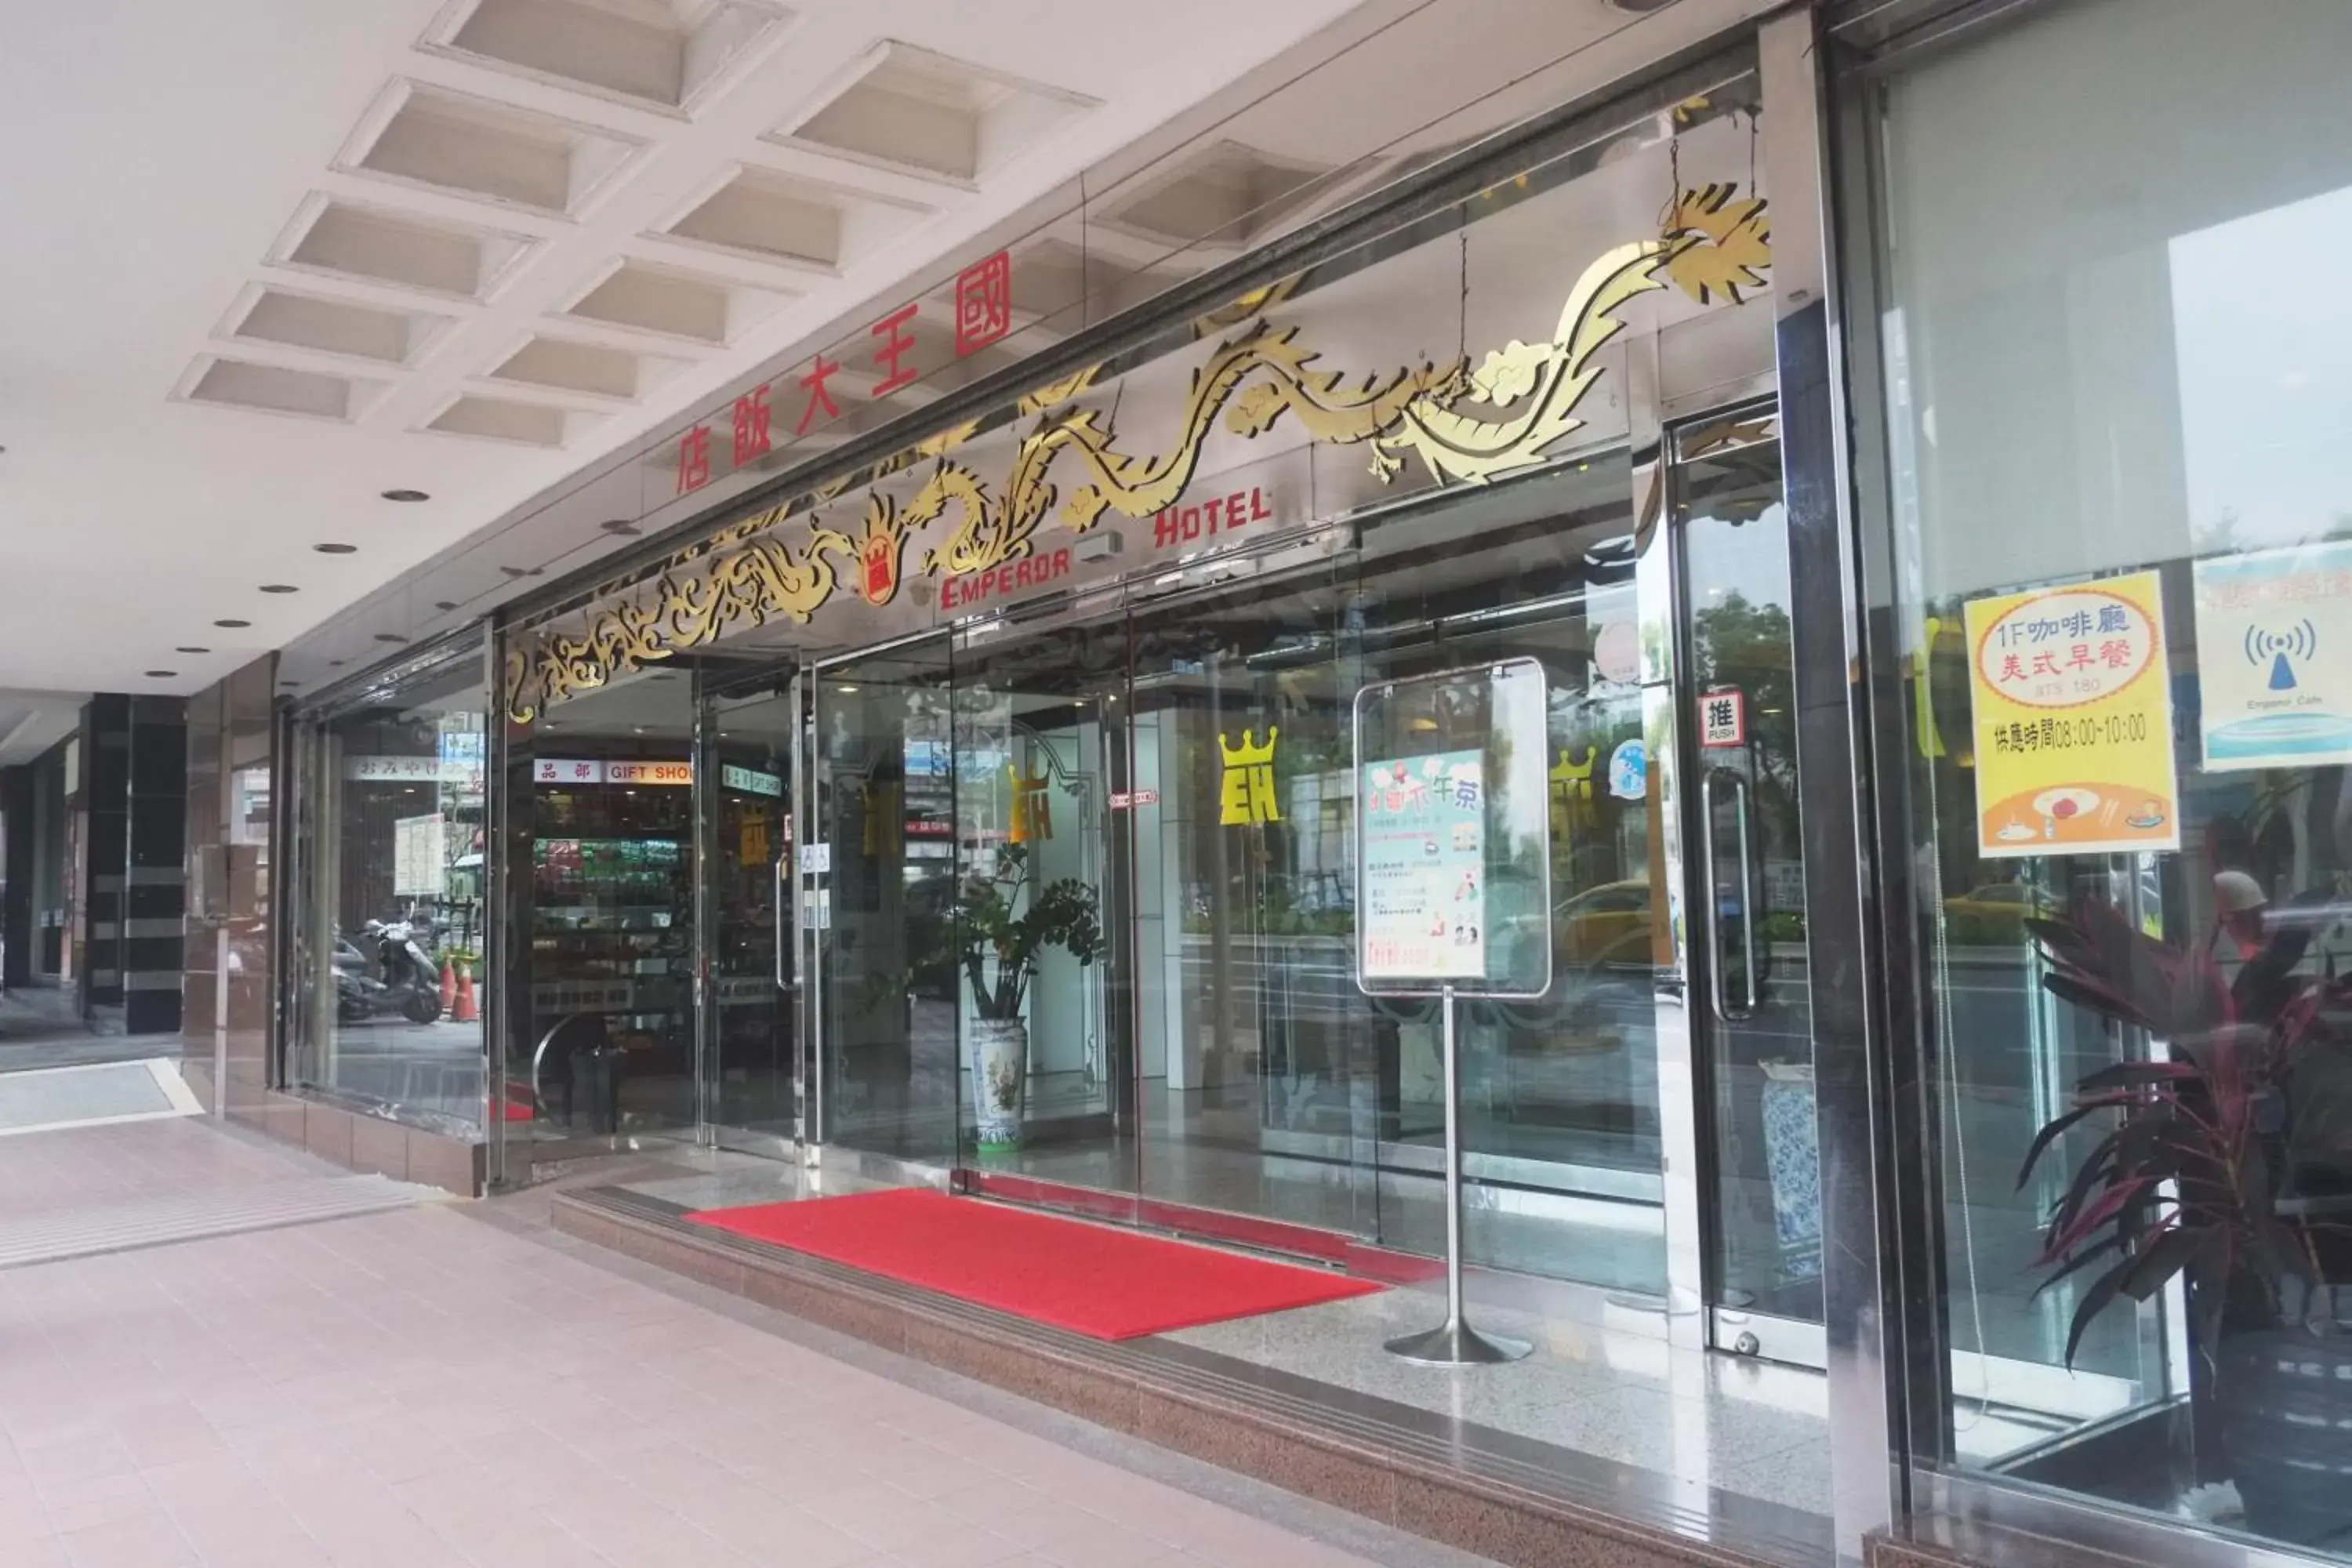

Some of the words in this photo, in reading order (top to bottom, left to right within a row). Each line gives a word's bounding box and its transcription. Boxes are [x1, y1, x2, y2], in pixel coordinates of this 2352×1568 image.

[941, 549, 1069, 611] EMPEROR
[1154, 486, 1272, 548] HOTEL
[1998, 604, 2131, 648] 1F咖啡廳
[1999, 639, 2132, 683] 美式早餐
[1708, 699, 1733, 728] 推
[1708, 729, 1735, 741] PUSH
[611, 766, 646, 779] GIFT
